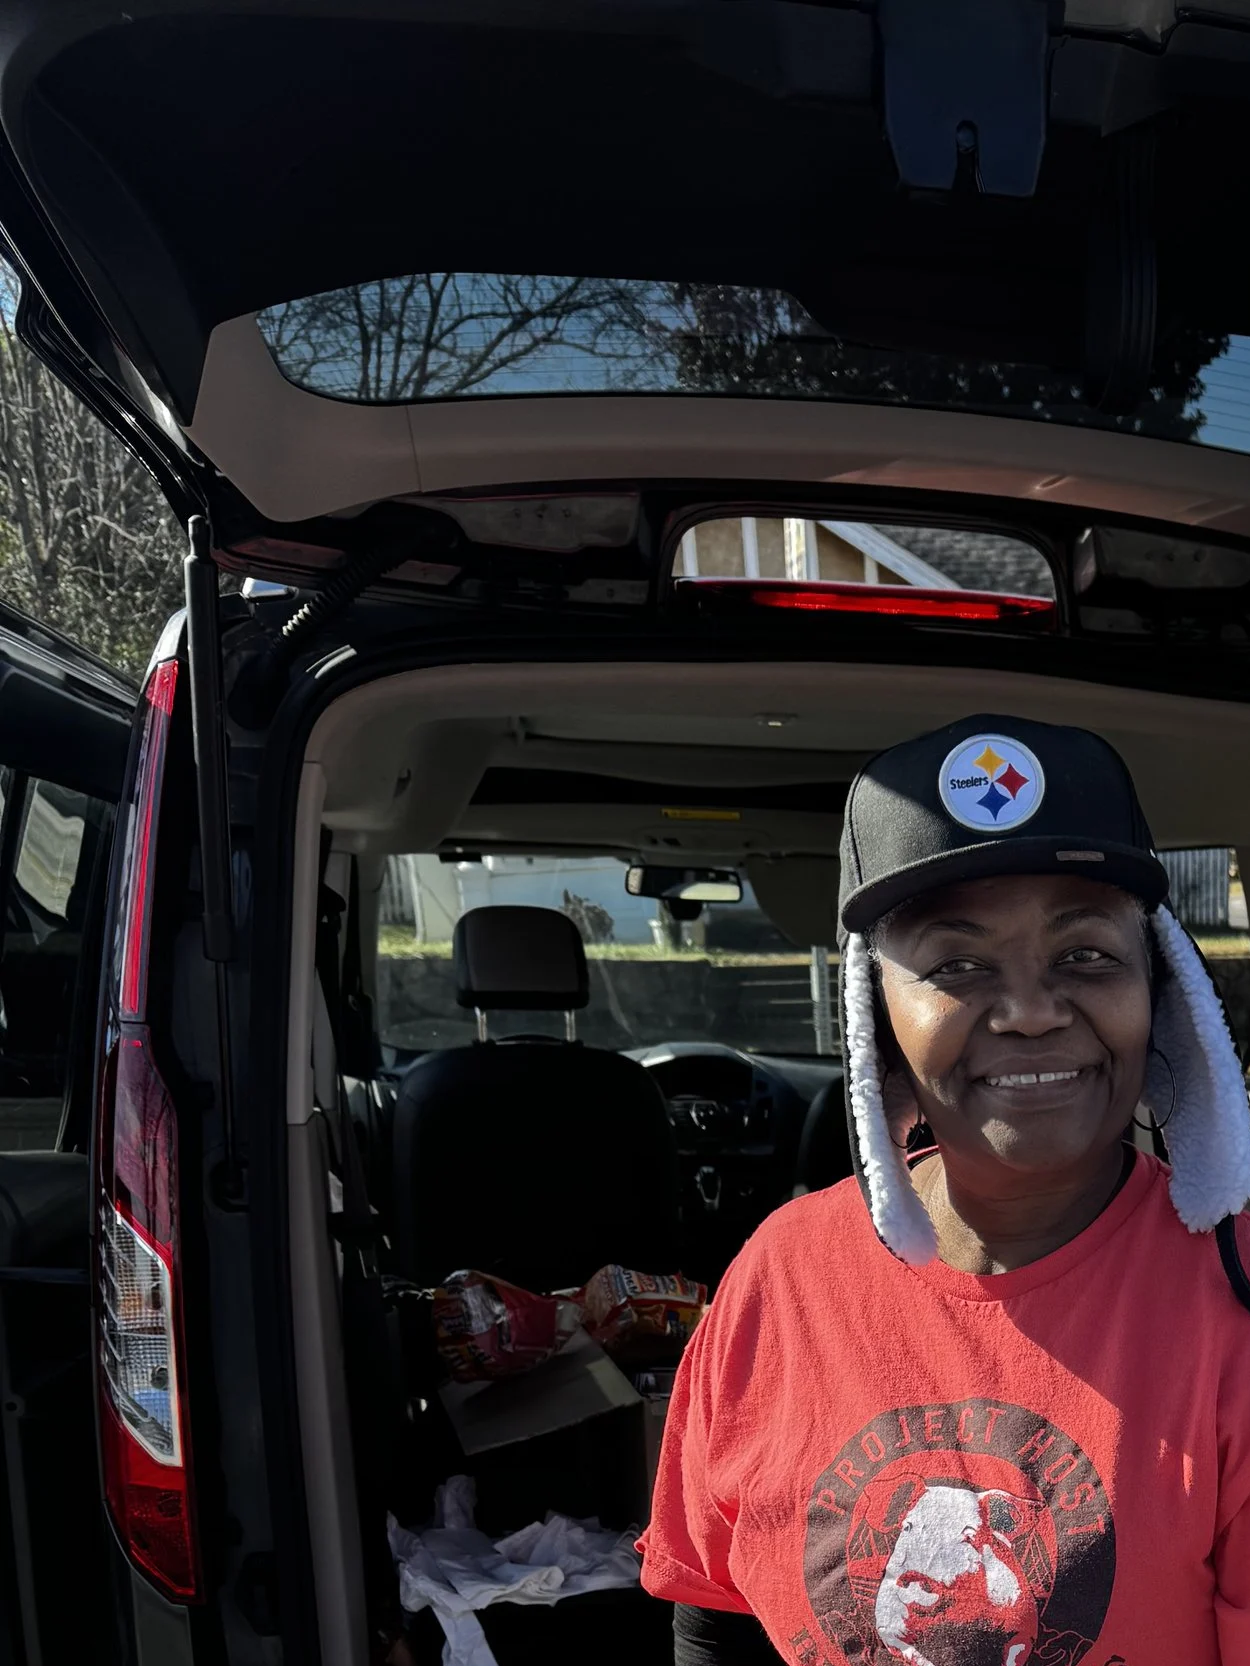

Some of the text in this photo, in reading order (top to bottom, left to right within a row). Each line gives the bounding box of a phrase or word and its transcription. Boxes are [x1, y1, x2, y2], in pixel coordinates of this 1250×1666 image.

[949, 776, 989, 790] Steelers
[817, 1406, 1107, 1537] PROJECT HOST
